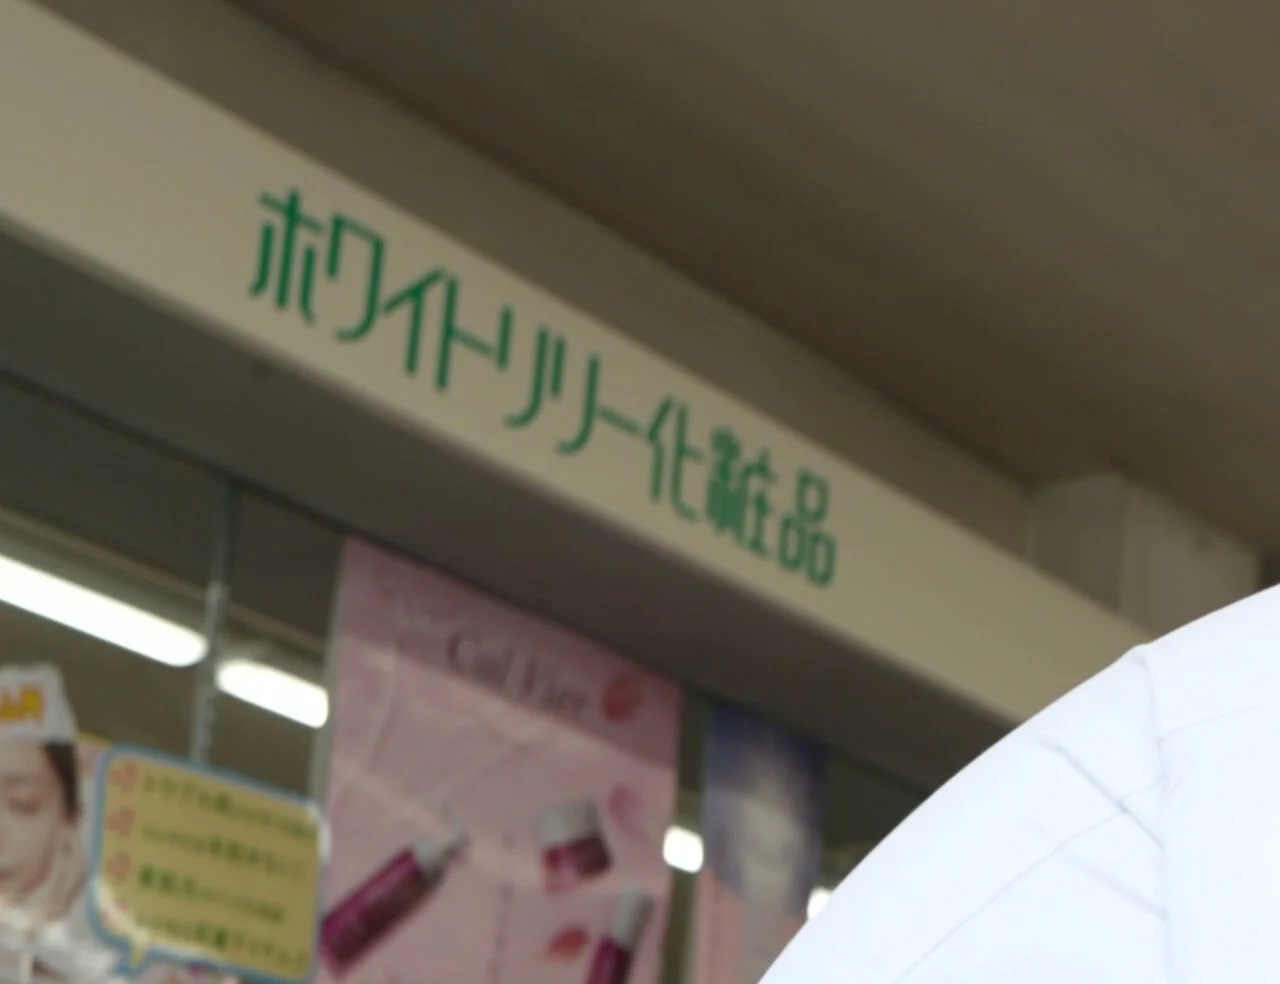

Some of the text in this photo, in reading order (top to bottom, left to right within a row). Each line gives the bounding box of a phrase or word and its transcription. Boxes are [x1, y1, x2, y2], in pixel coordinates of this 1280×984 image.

[250, 188, 838, 588] ホワイトリリー化粧品
